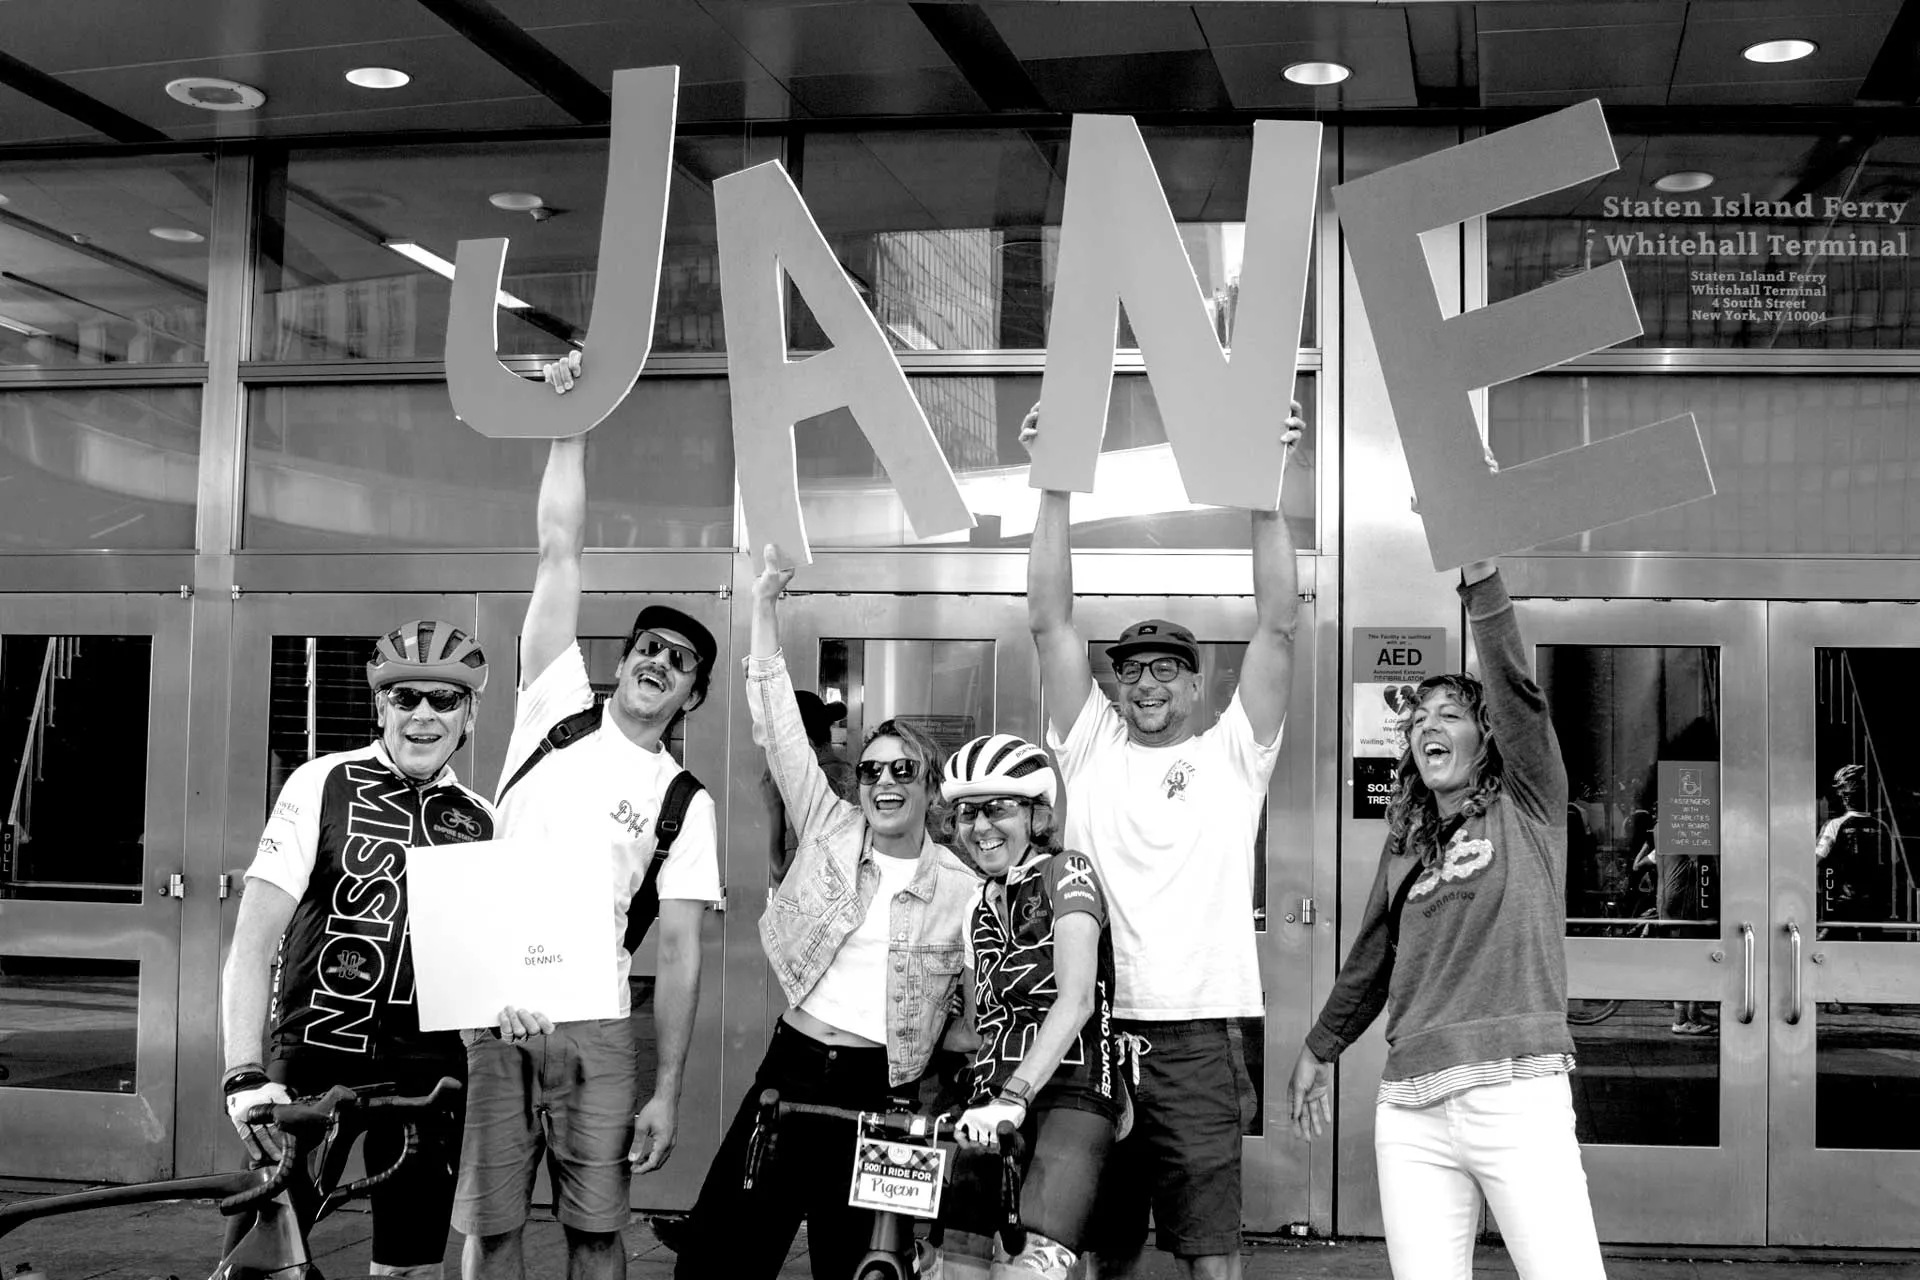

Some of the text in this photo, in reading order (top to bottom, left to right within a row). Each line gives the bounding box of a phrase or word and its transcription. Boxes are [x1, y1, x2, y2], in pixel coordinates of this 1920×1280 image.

[1602, 192, 1908, 224] Staten Island Ferry
[1603, 231, 1909, 257] Whitehall Terminal
[1690, 270, 1827, 285] Staten Island Ferry
[1691, 284, 1827, 297] Whitehall Terminal
[1711, 297, 1806, 309] 4 South Street
[1691, 309, 1827, 324] New York, NY 10004
[1376, 648, 1422, 666] AED
[2, 832, 12, 872] PULL
[1700, 865, 1709, 909] PULL
[1825, 867, 1835, 911] PULL
[303, 764, 414, 1054] MISSION
[527, 944, 545, 955] GO
[524, 953, 564, 967] DENNIS
[888, 1166, 911, 1179] RIDE
[911, 1171, 932, 1182] FOR
[871, 1177, 920, 1199] Pigeon
